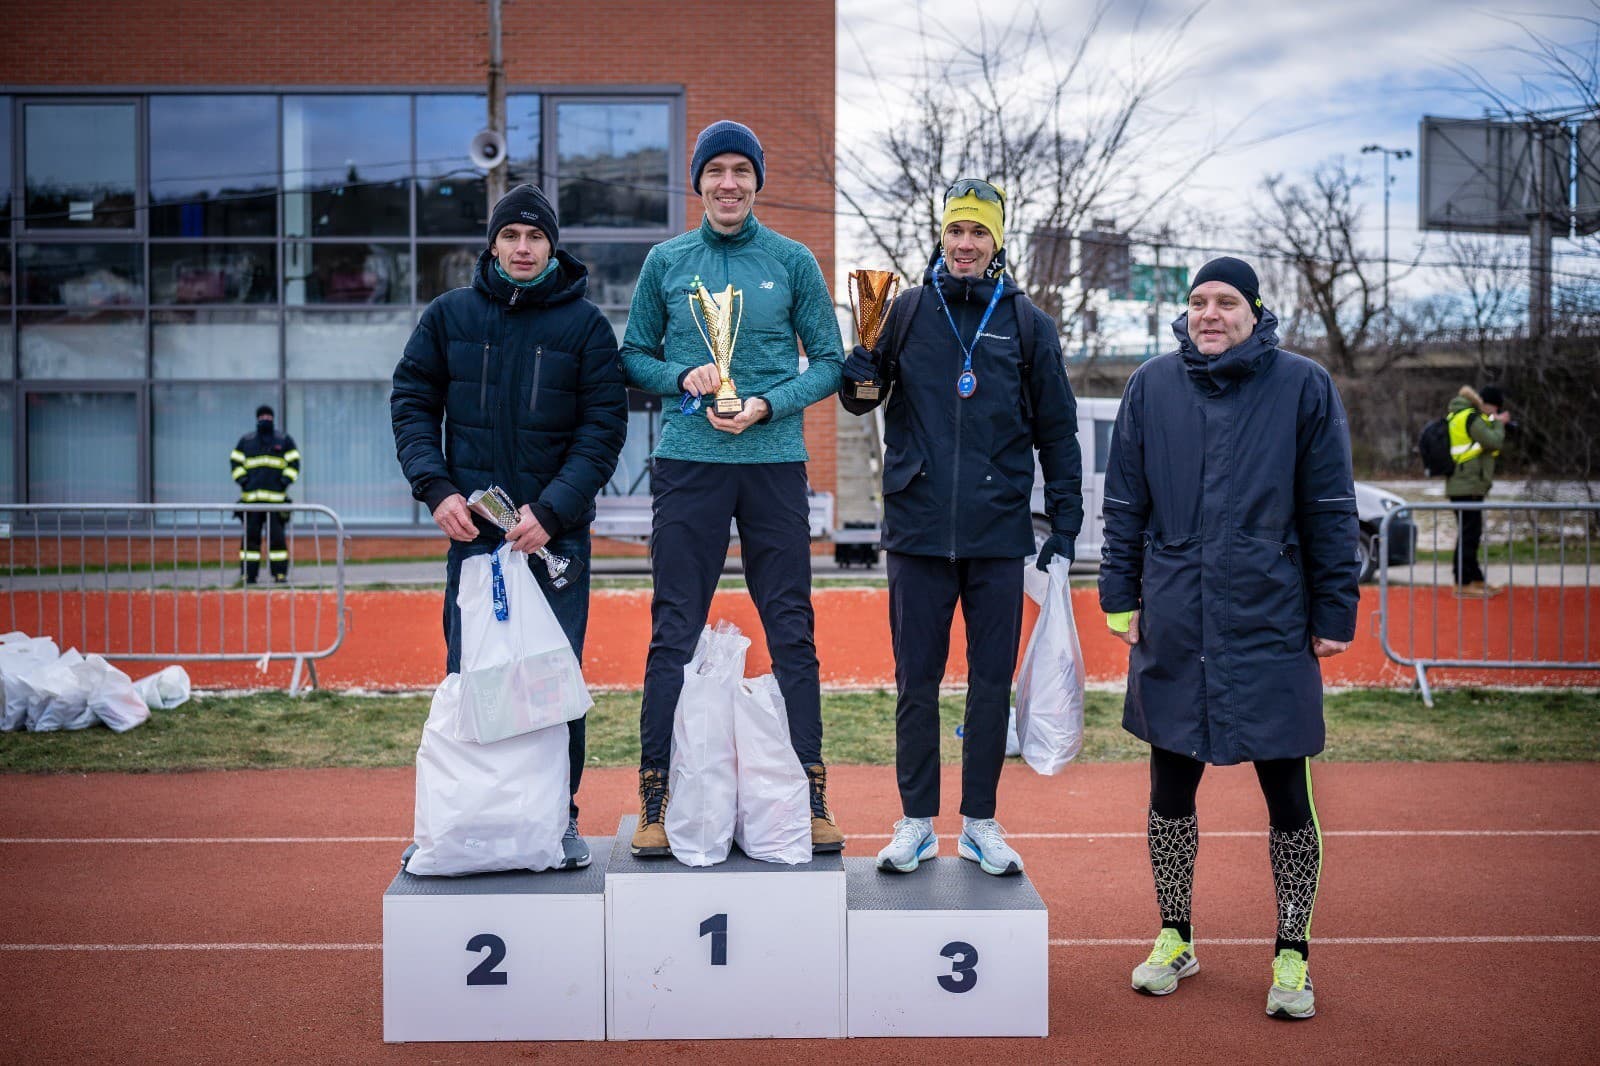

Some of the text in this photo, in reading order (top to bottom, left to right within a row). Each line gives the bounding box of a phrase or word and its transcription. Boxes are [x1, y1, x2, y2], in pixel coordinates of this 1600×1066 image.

[465, 934, 508, 986] 2
[699, 914, 728, 966] 1
[936, 942, 979, 994] 3
